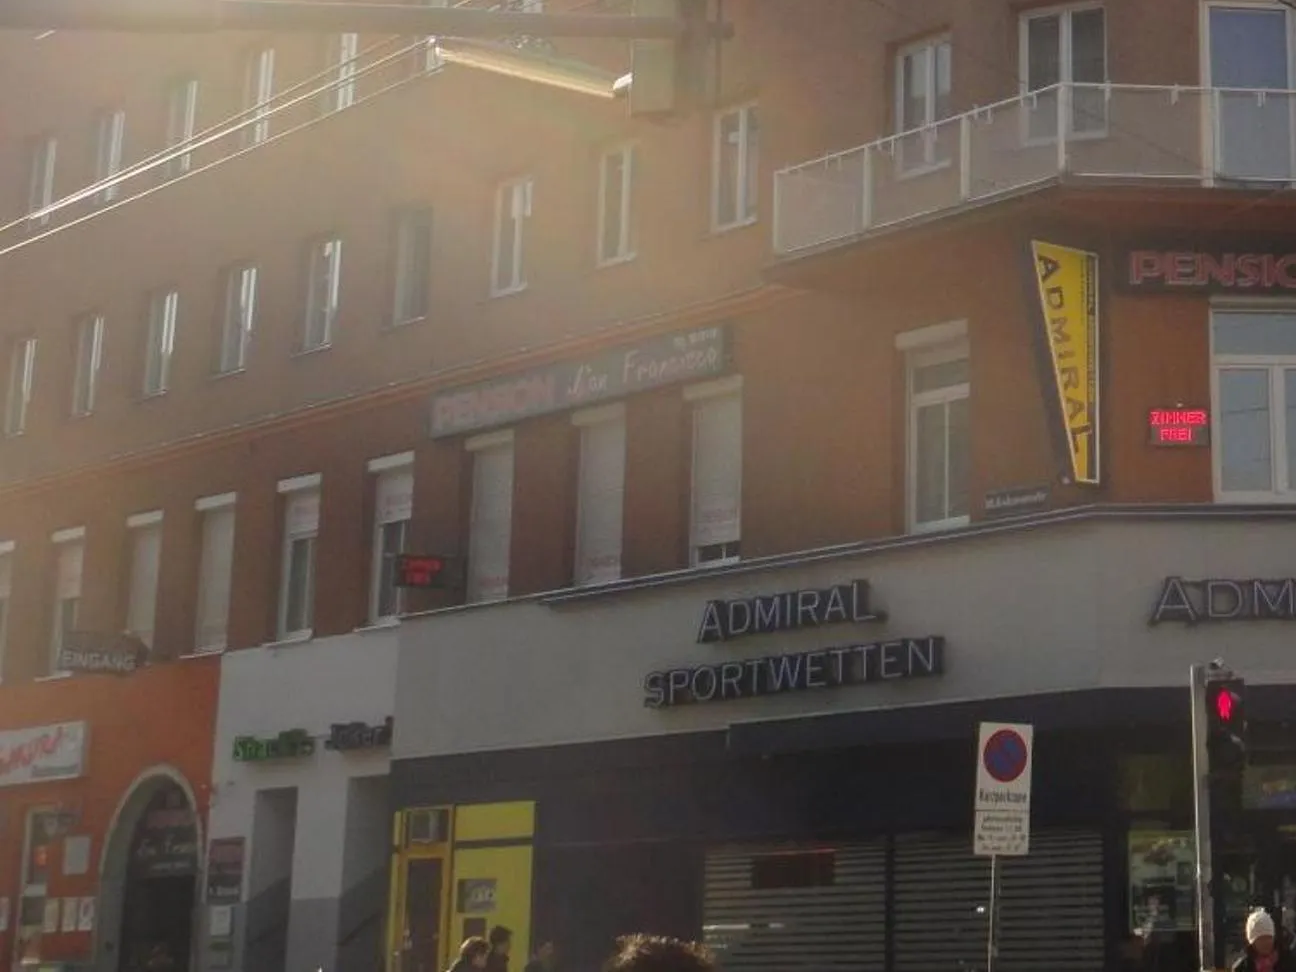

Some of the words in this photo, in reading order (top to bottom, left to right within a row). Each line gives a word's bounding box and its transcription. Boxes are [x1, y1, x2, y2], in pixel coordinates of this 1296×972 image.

[1036, 254, 1093, 455] ADMIRAL
[1150, 411, 1207, 425] ZIMMER
[1160, 428, 1192, 441] FREI
[697, 580, 886, 643] ADMIRAL
[643, 636, 944, 709] SPORTWETTEN
